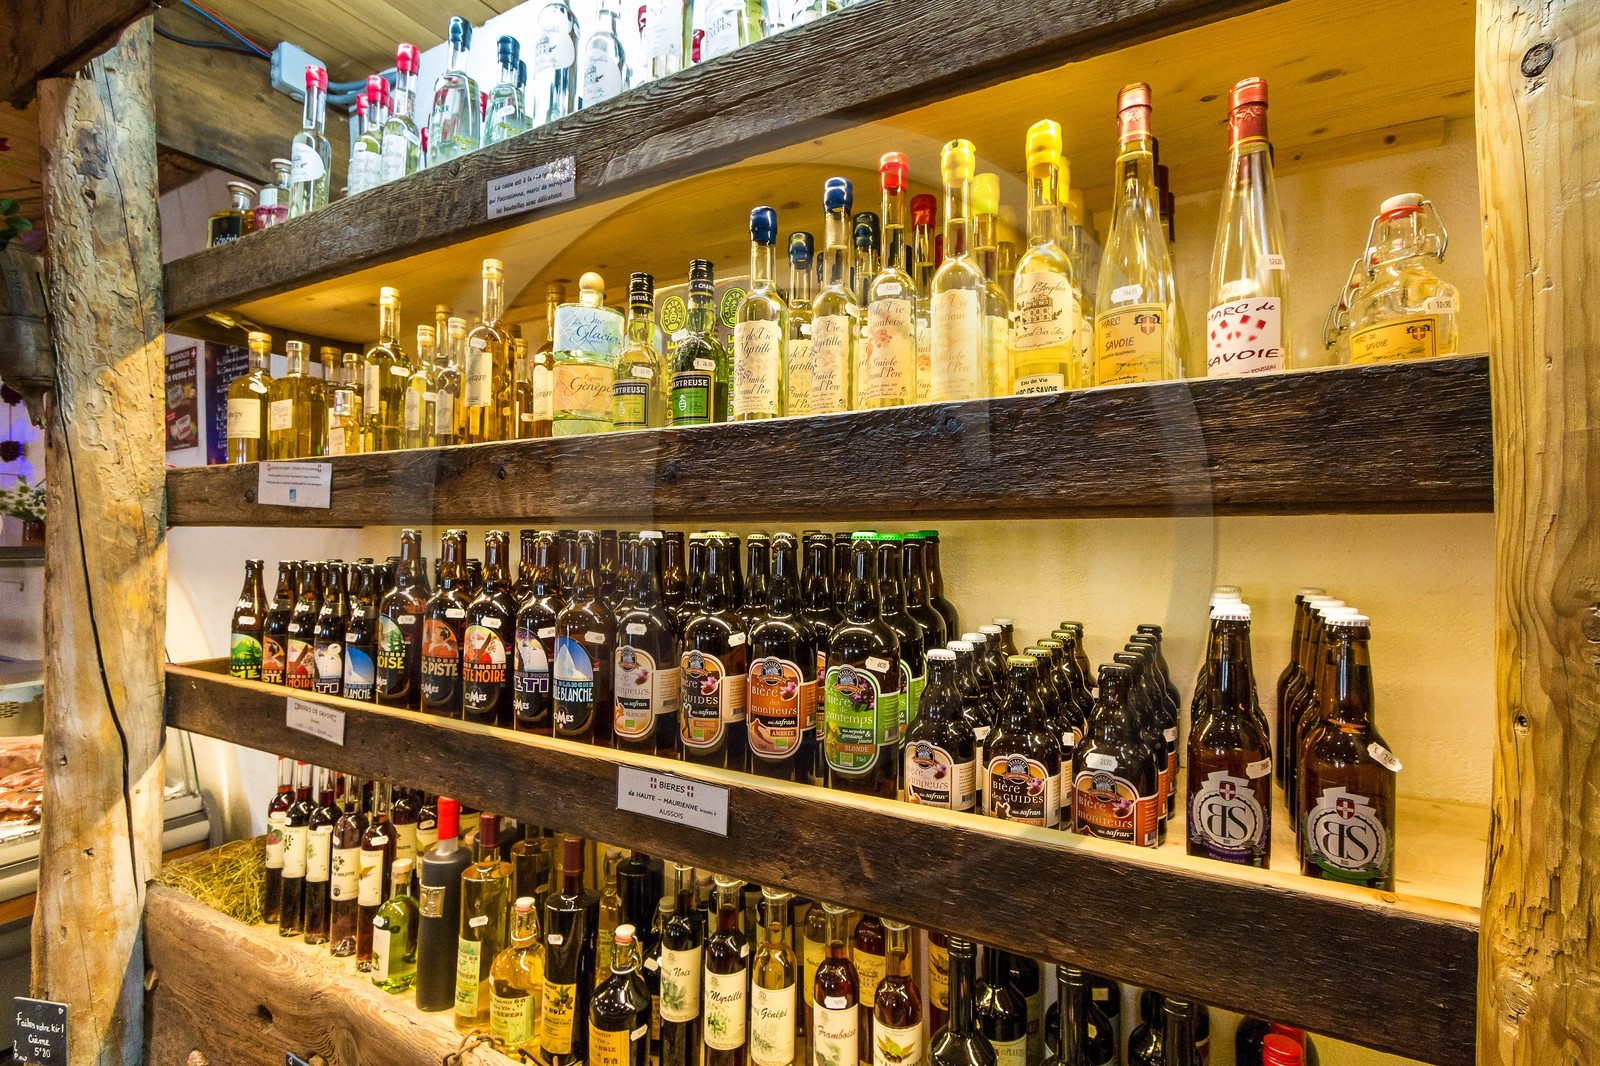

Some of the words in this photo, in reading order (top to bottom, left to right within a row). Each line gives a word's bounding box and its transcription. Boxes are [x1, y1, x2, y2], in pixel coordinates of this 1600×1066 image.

[1255, 302, 1276, 312] de
[1105, 336, 1134, 352] SAVOIE
[1208, 348, 1280, 370] SAVOIE
[672, 379, 708, 388] ARTREUSE
[377, 656, 404, 669] OISE
[475, 669, 506, 683] NOIRE
[514, 676, 550, 692] ETI
[752, 682, 778, 697] Bière
[560, 687, 593, 702] BLANCHE
[698, 708, 718, 716] safran
[751, 705, 798, 716] moniteurs
[774, 718, 796, 727] safran
[865, 730, 872, 738] &
[658, 780, 686, 794] BIERES
[992, 778, 1021, 794] Bière
[636, 792, 656, 802] HAUTE
[662, 798, 699, 812] MAURIENNE
[926, 792, 946, 800] safran
[992, 792, 1002, 800] des
[1003, 793, 1044, 804] GUIDES
[1078, 794, 1107, 812] Bière
[658, 808, 685, 820] AUSSOIS
[1020, 808, 1042, 818] safran
[1078, 810, 1133, 828] moniteurs
[1106, 829, 1131, 838] safran
[673, 966, 691, 978] Noix
[710, 990, 742, 1004] Myrtille
[760, 1008, 788, 1020] Génépi
[817, 1024, 857, 1040] Framboise
